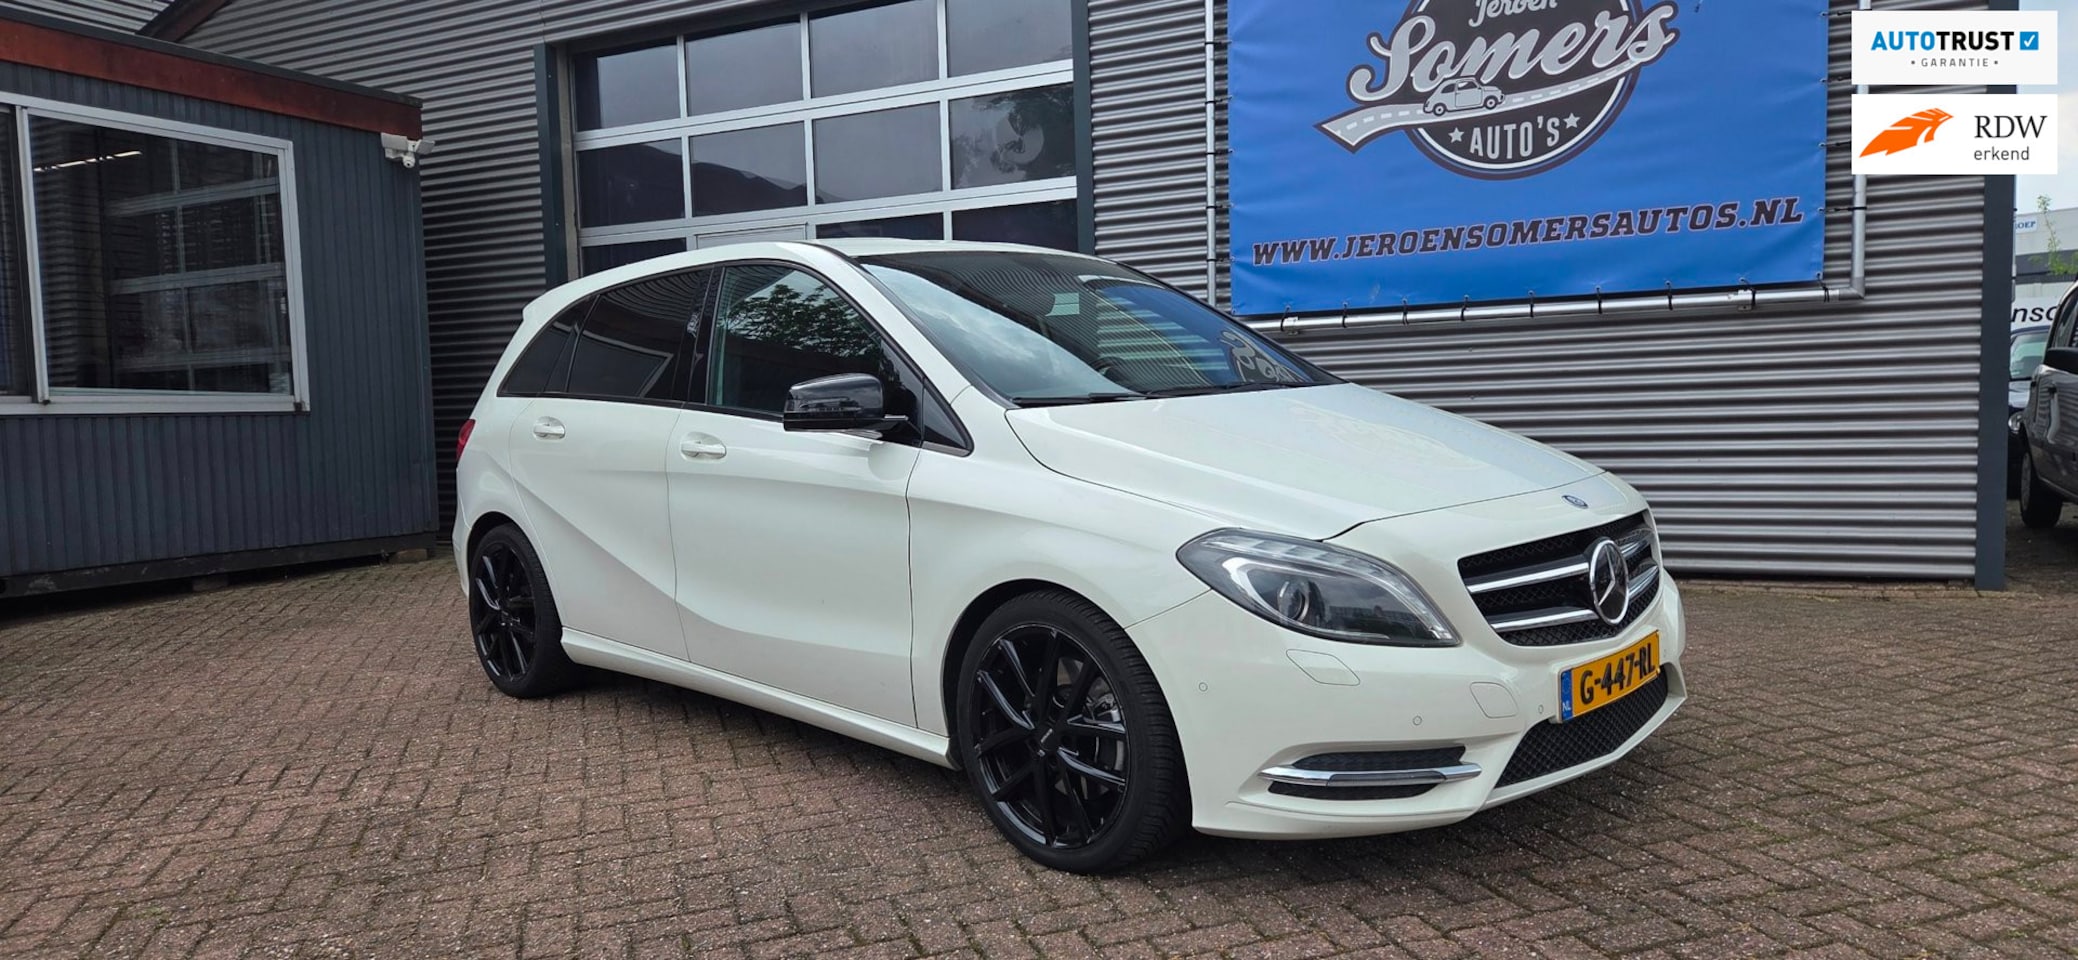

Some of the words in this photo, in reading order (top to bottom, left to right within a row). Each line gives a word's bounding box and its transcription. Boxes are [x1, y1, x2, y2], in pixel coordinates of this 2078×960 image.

[1350, 5, 1675, 101] Somers
[1469, 115, 1560, 160] AUTO'S
[1252, 197, 1803, 266] WWW.JEROENSOMERSAUTOS.NL
[1580, 642, 1656, 705] G-447-RL
[1562, 700, 1571, 712] NL
